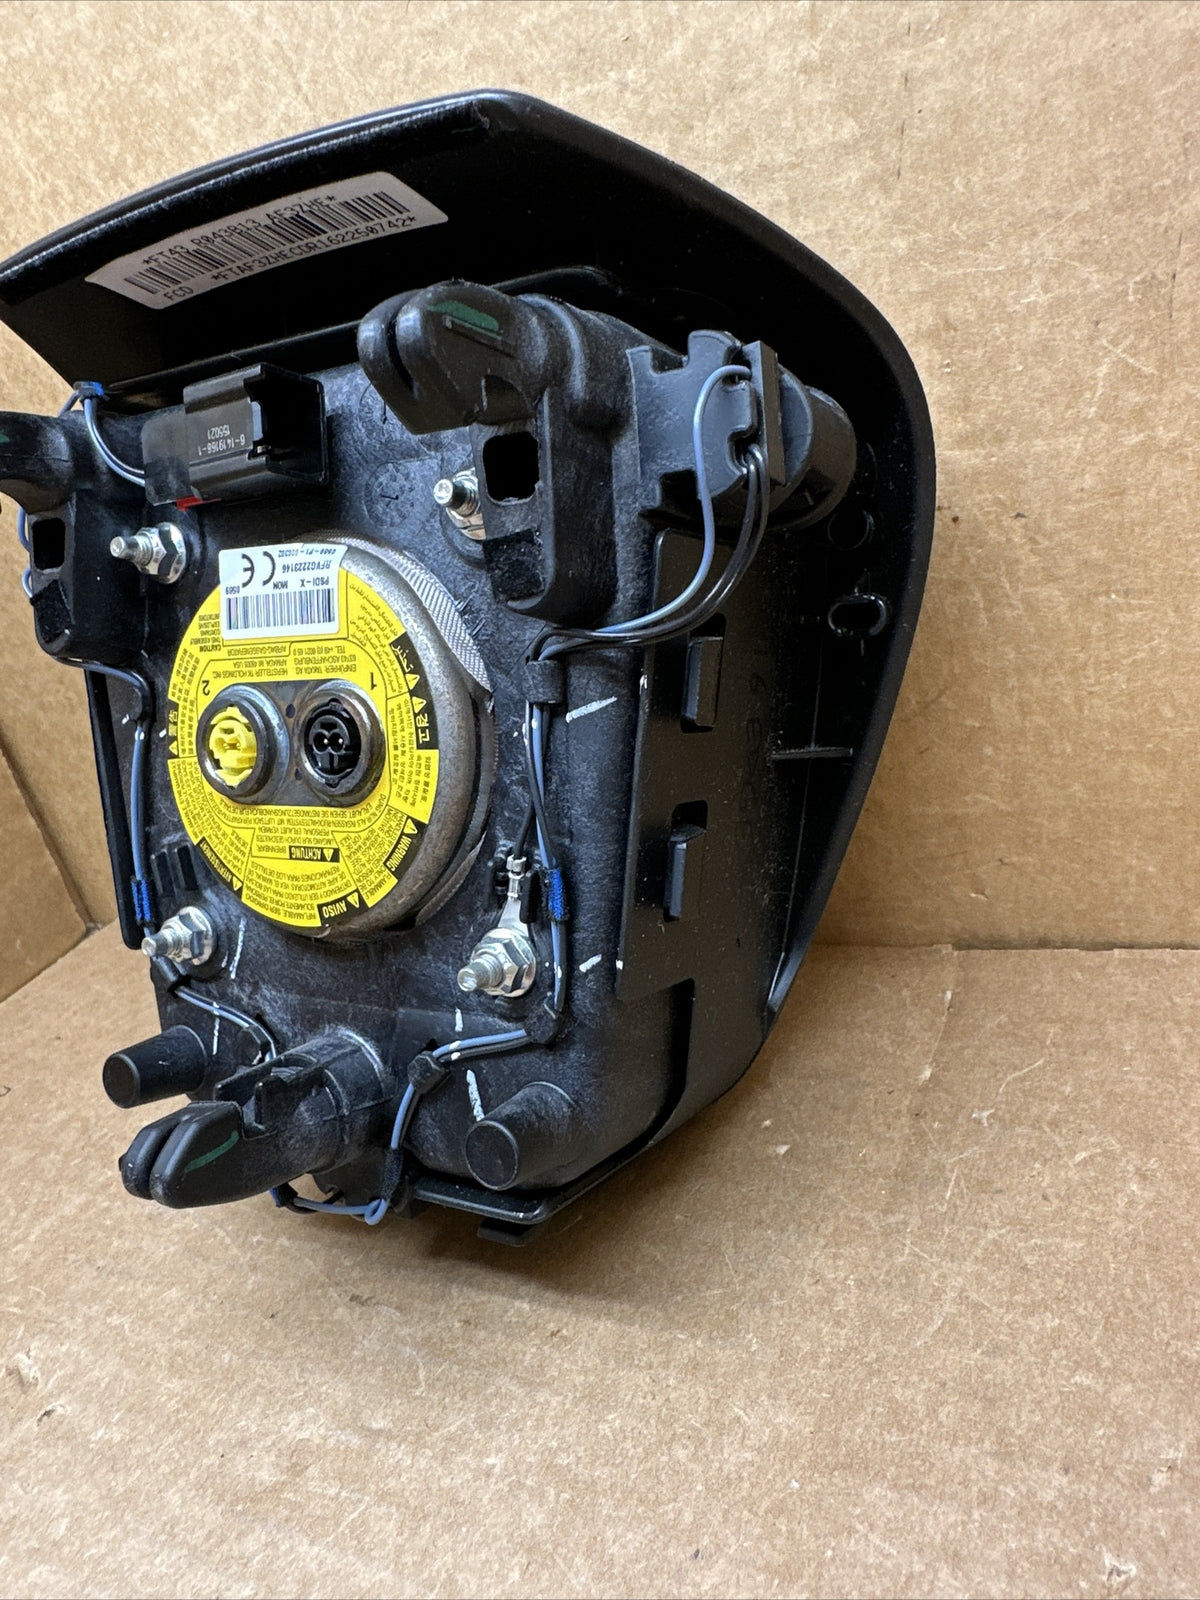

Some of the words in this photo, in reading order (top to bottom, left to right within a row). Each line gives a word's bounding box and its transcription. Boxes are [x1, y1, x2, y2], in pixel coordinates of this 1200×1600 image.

[202, 680, 210, 696] 2
[370, 672, 377, 691] 1
[291, 845, 321, 859] ACHTUNG
[386, 835, 412, 871] WARNING
[322, 900, 347, 918] AVISO
